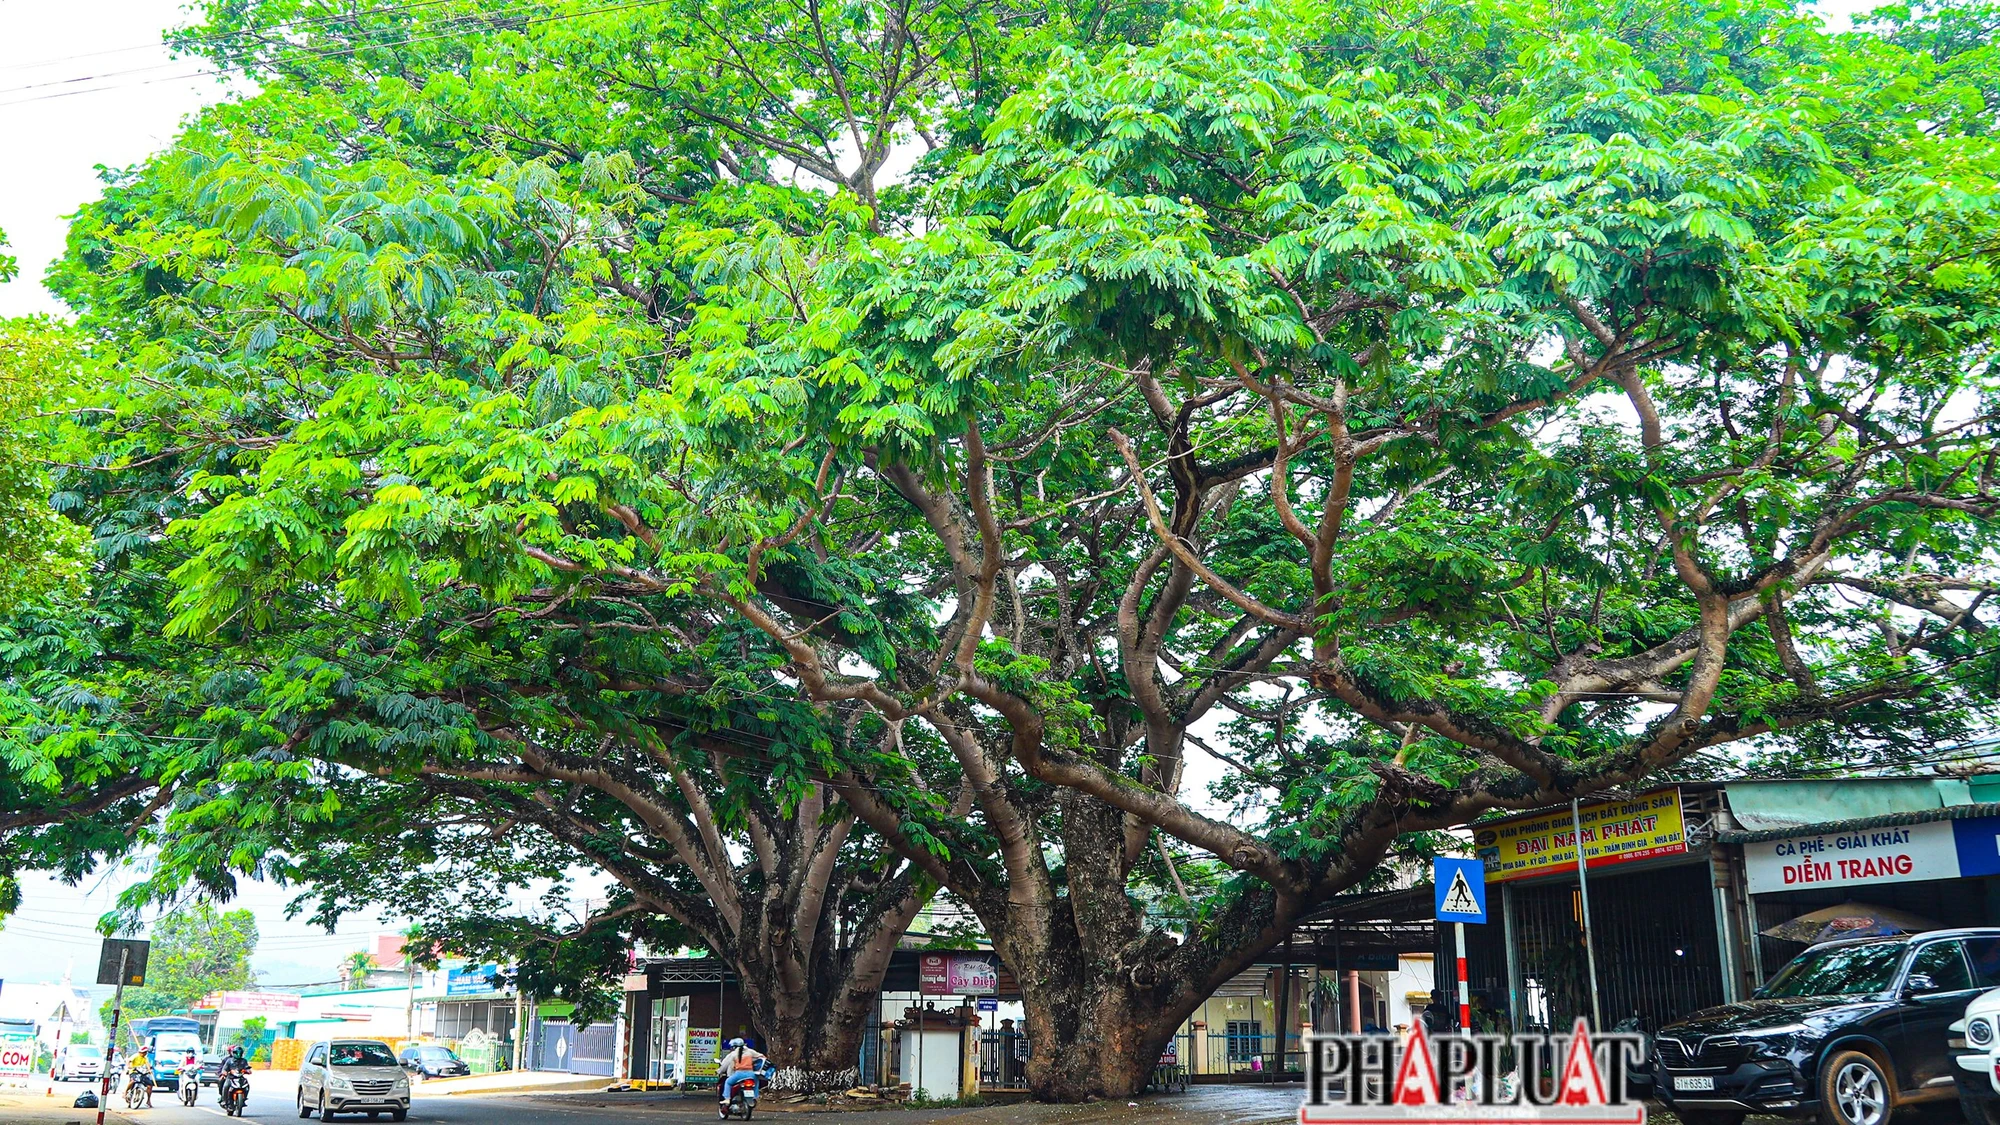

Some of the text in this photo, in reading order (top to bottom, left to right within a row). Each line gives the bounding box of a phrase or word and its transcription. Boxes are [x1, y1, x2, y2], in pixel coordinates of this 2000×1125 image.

[1519, 820, 1550, 835] PHÒNG
[1552, 816, 1573, 829] GIAO
[1600, 804, 1619, 819] BẤT
[1621, 801, 1649, 816] ĐỘNG
[1652, 794, 1674, 809] SẢN
[1516, 813, 1659, 855] ĐẠI NAM PHÁT
[1775, 839, 1797, 857] CÀ
[1800, 835, 1825, 854] PHÊ
[1836, 831, 1867, 850] GIẢI
[1872, 827, 1910, 847] KHÁT
[1783, 854, 1913, 884] DIỄM TRANG
[951, 976, 969, 987] Cây
[972, 975, 997, 988] Điệp
